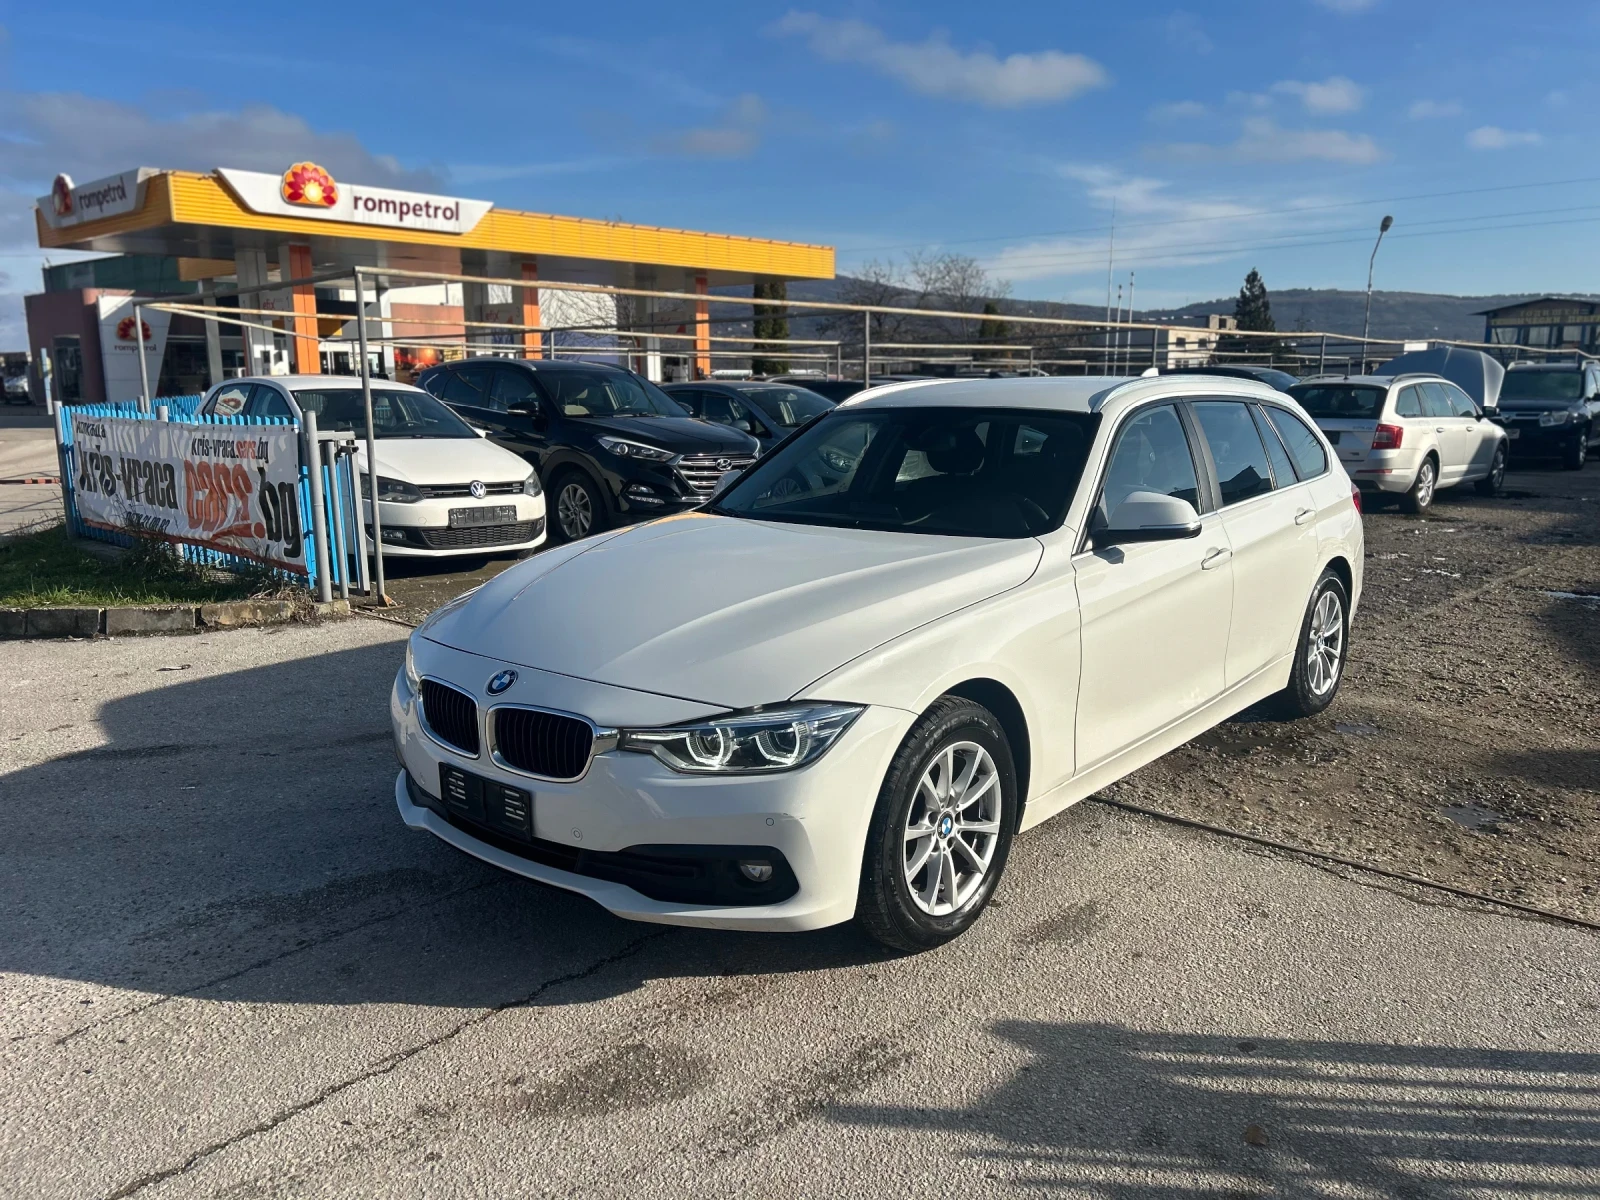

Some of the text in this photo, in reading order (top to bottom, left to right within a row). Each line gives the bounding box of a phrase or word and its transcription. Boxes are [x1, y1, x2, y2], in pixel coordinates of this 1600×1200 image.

[78, 174, 127, 213] rompetrol
[353, 195, 460, 222] rompetrol
[114, 344, 157, 353] romprol
[191, 434, 269, 463] kris-vraca.cars.bg
[77, 440, 179, 510] kris-vraca
